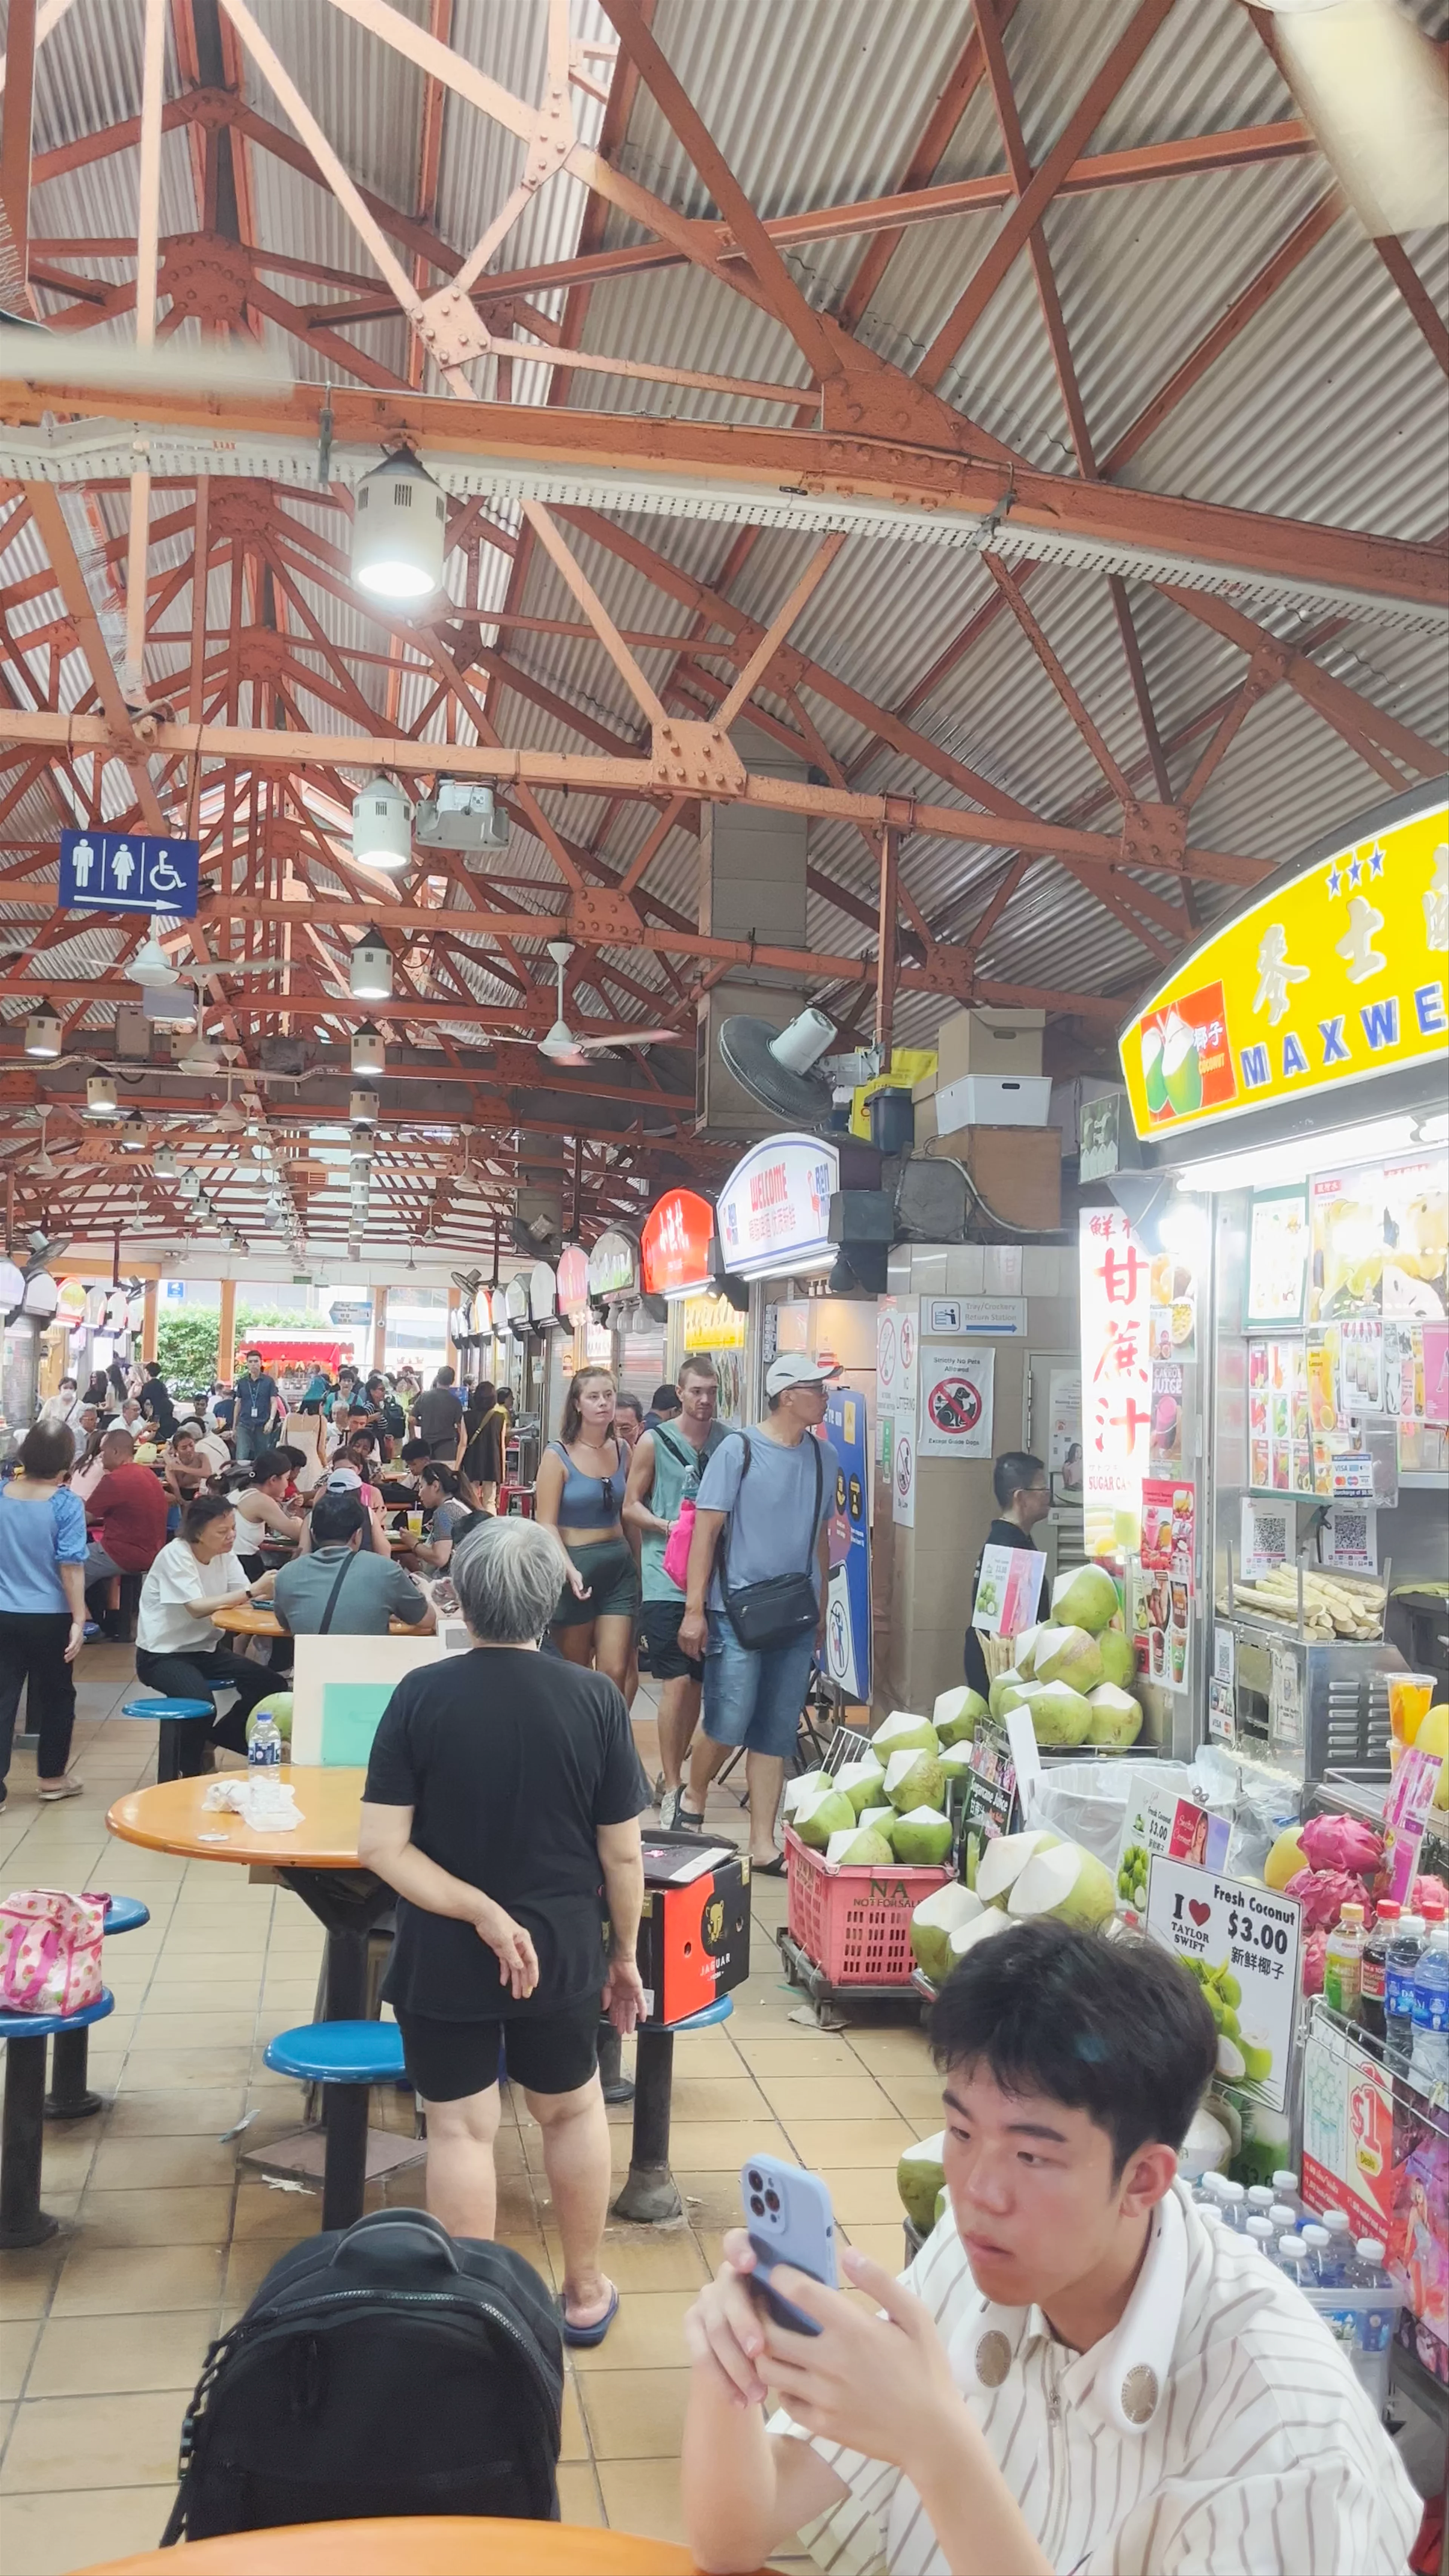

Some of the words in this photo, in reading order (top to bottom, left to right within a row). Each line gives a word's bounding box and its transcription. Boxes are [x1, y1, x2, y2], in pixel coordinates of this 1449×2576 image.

[1193, 1021, 1223, 1052] 椰子
[1199, 1053, 1225, 1074] COCONUT
[750, 1162, 787, 1212] WELCOME
[966, 1302, 1016, 1311] Tray/Crockery
[1093, 1246, 1151, 1457] 甘蔗汁
[1154, 1368, 1181, 1378] CARROT
[1152, 1378, 1182, 1394] JUICE
[1089, 1476, 1114, 1490] SUGAR
[970, 1775, 994, 1803] Sugarcane
[993, 1792, 1008, 1812] Juice
[1147, 1806, 1157, 1818] Fresh
[1149, 1819, 1168, 1841] $3.00
[869, 1878, 909, 1898] NA
[854, 1898, 876, 1907] NOT
[878, 1899, 897, 1907] FOR
[1173, 1893, 1184, 1920] I
[1214, 1884, 1244, 1909] Fresh
[1249, 1897, 1295, 1926] Coconut
[1171, 1922, 1210, 1944] TAYLOR
[1227, 1909, 1288, 1955] $3.00
[1174, 1935, 1206, 1953] SWIFT
[700, 1953, 731, 1976] JAGUAR
[1231, 1946, 1284, 1980] 新鲜椰子
